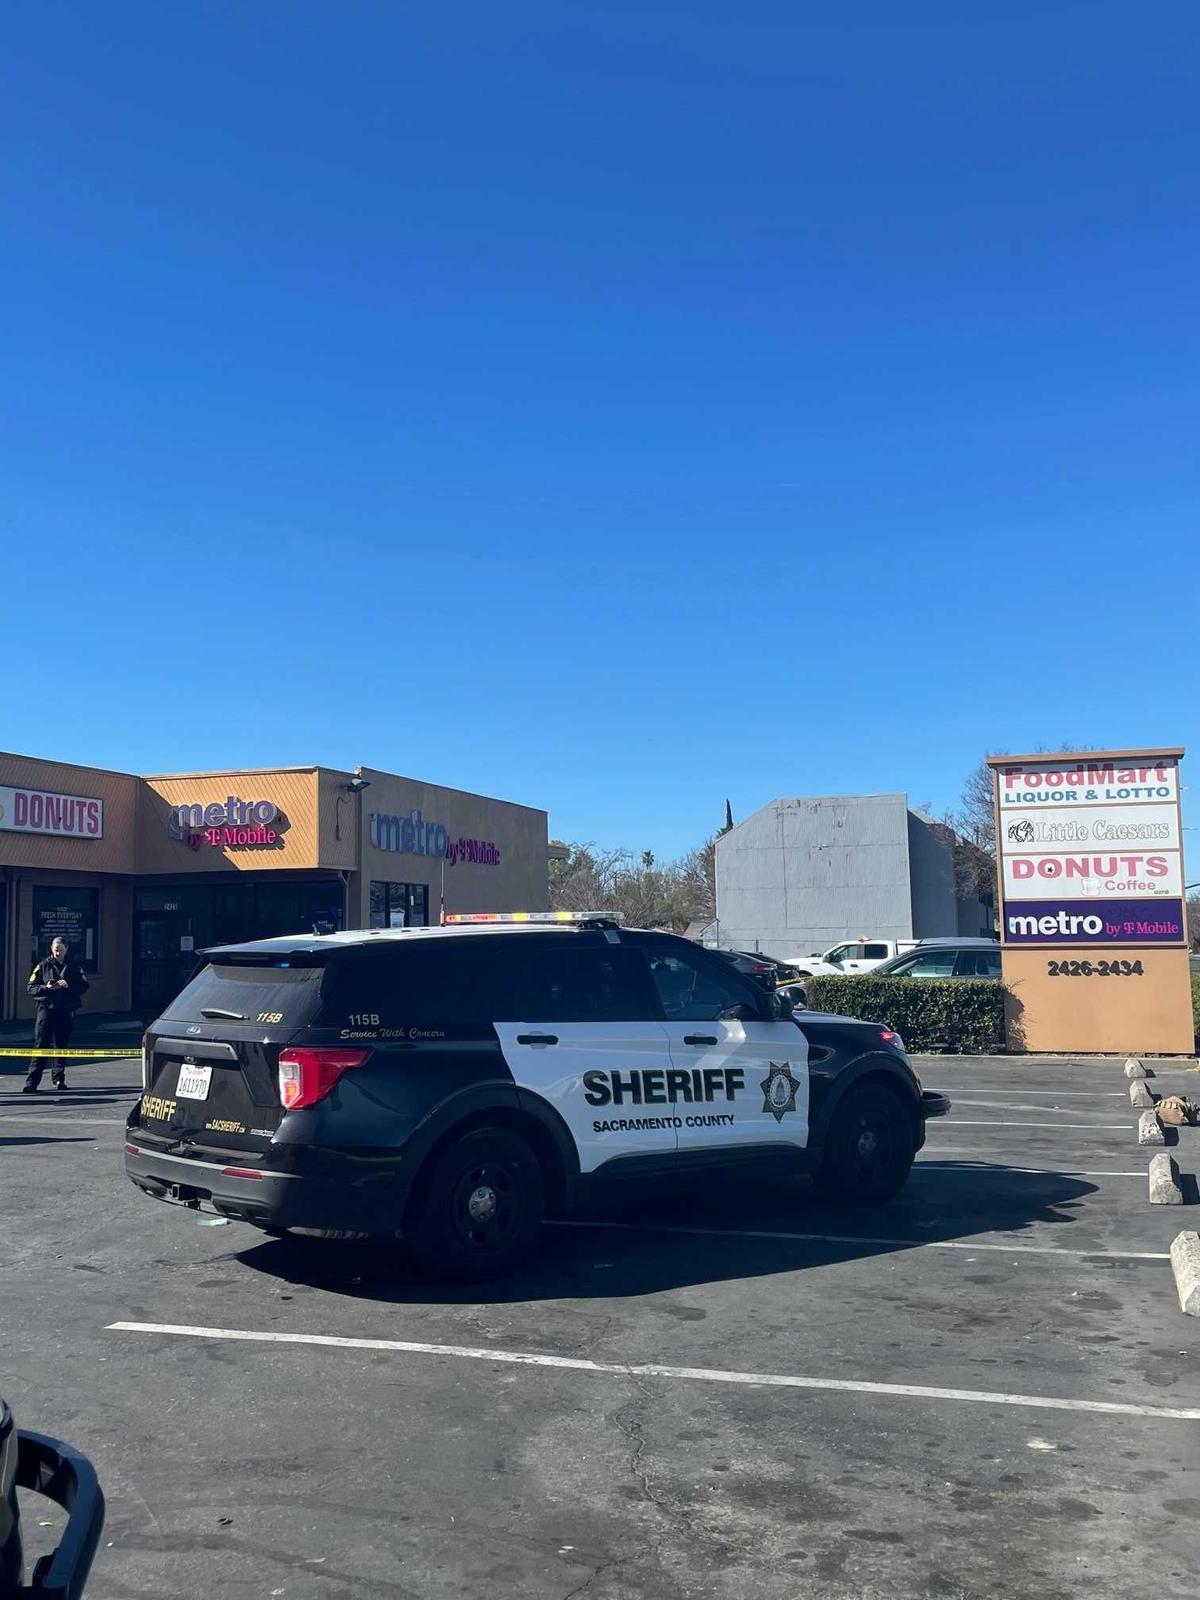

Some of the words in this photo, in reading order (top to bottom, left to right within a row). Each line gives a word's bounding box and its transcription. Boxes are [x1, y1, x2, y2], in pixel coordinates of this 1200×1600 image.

[1005, 760, 1168, 788] FoodMart
[1005, 790, 1078, 803] LIQUOR
[1085, 789, 1098, 800] &
[1106, 787, 1170, 799] LOTTO
[14, 792, 99, 834] DONUTS
[171, 795, 277, 827] metro
[184, 829, 201, 850] by
[369, 810, 449, 858] metro
[1036, 821, 1089, 842] Little
[1092, 819, 1169, 840] Caesars
[1012, 856, 1169, 879] DONUTS
[1105, 880, 1156, 891] Coffee
[1009, 911, 1103, 935] metro
[1106, 923, 1120, 937] by
[1048, 960, 1144, 977] 2426-2434
[255, 1011, 283, 1023] 115B
[348, 1014, 380, 1026] 115B
[339, 1029, 378, 1039] Service
[379, 1028, 405, 1038] With
[408, 1027, 446, 1039] Concern
[582, 1068, 746, 1106] SHERIFF
[140, 1095, 177, 1121] SHERIFF
[592, 1117, 683, 1133] SACRAMENTO
[685, 1114, 735, 1128] COUNTY
